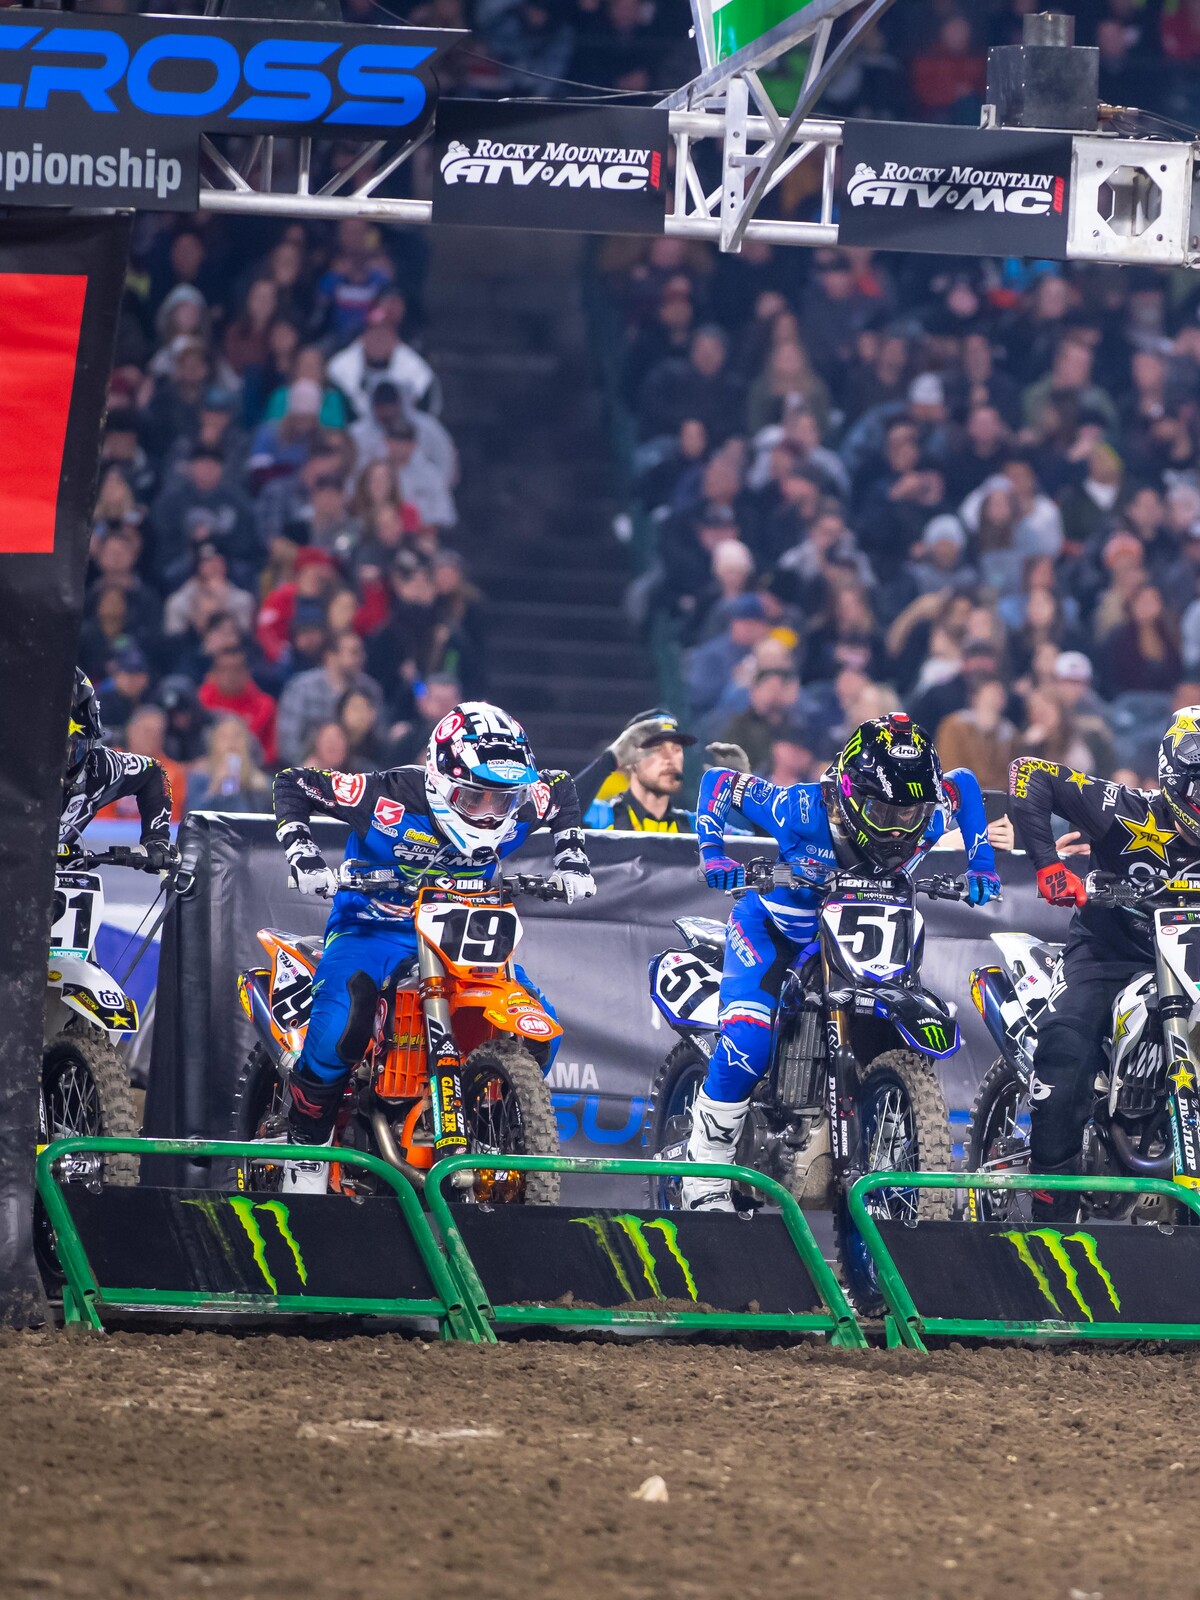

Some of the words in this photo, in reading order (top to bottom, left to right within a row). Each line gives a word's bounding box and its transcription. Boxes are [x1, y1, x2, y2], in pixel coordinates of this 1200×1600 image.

[473, 139, 541, 160] ROCKY
[541, 142, 651, 165] MOUNTAIN
[0, 143, 182, 198] pionship
[880, 162, 946, 183] ROCKY
[947, 166, 1054, 190] MOUNTAIN
[893, 747, 918, 756] Arai
[838, 879, 895, 889] RENTHAL
[864, 893, 895, 901] MONSTER
[1049, 880, 1067, 898] 15
[432, 909, 517, 962] 19
[837, 905, 913, 965] 51
[53, 951, 84, 959] MOTOREX
[916, 1017, 943, 1026] YAMAHA
[454, 1074, 466, 1136] DUOP
[829, 1075, 839, 1160] DUNLOP
[841, 1120, 849, 1156] BRAKING
